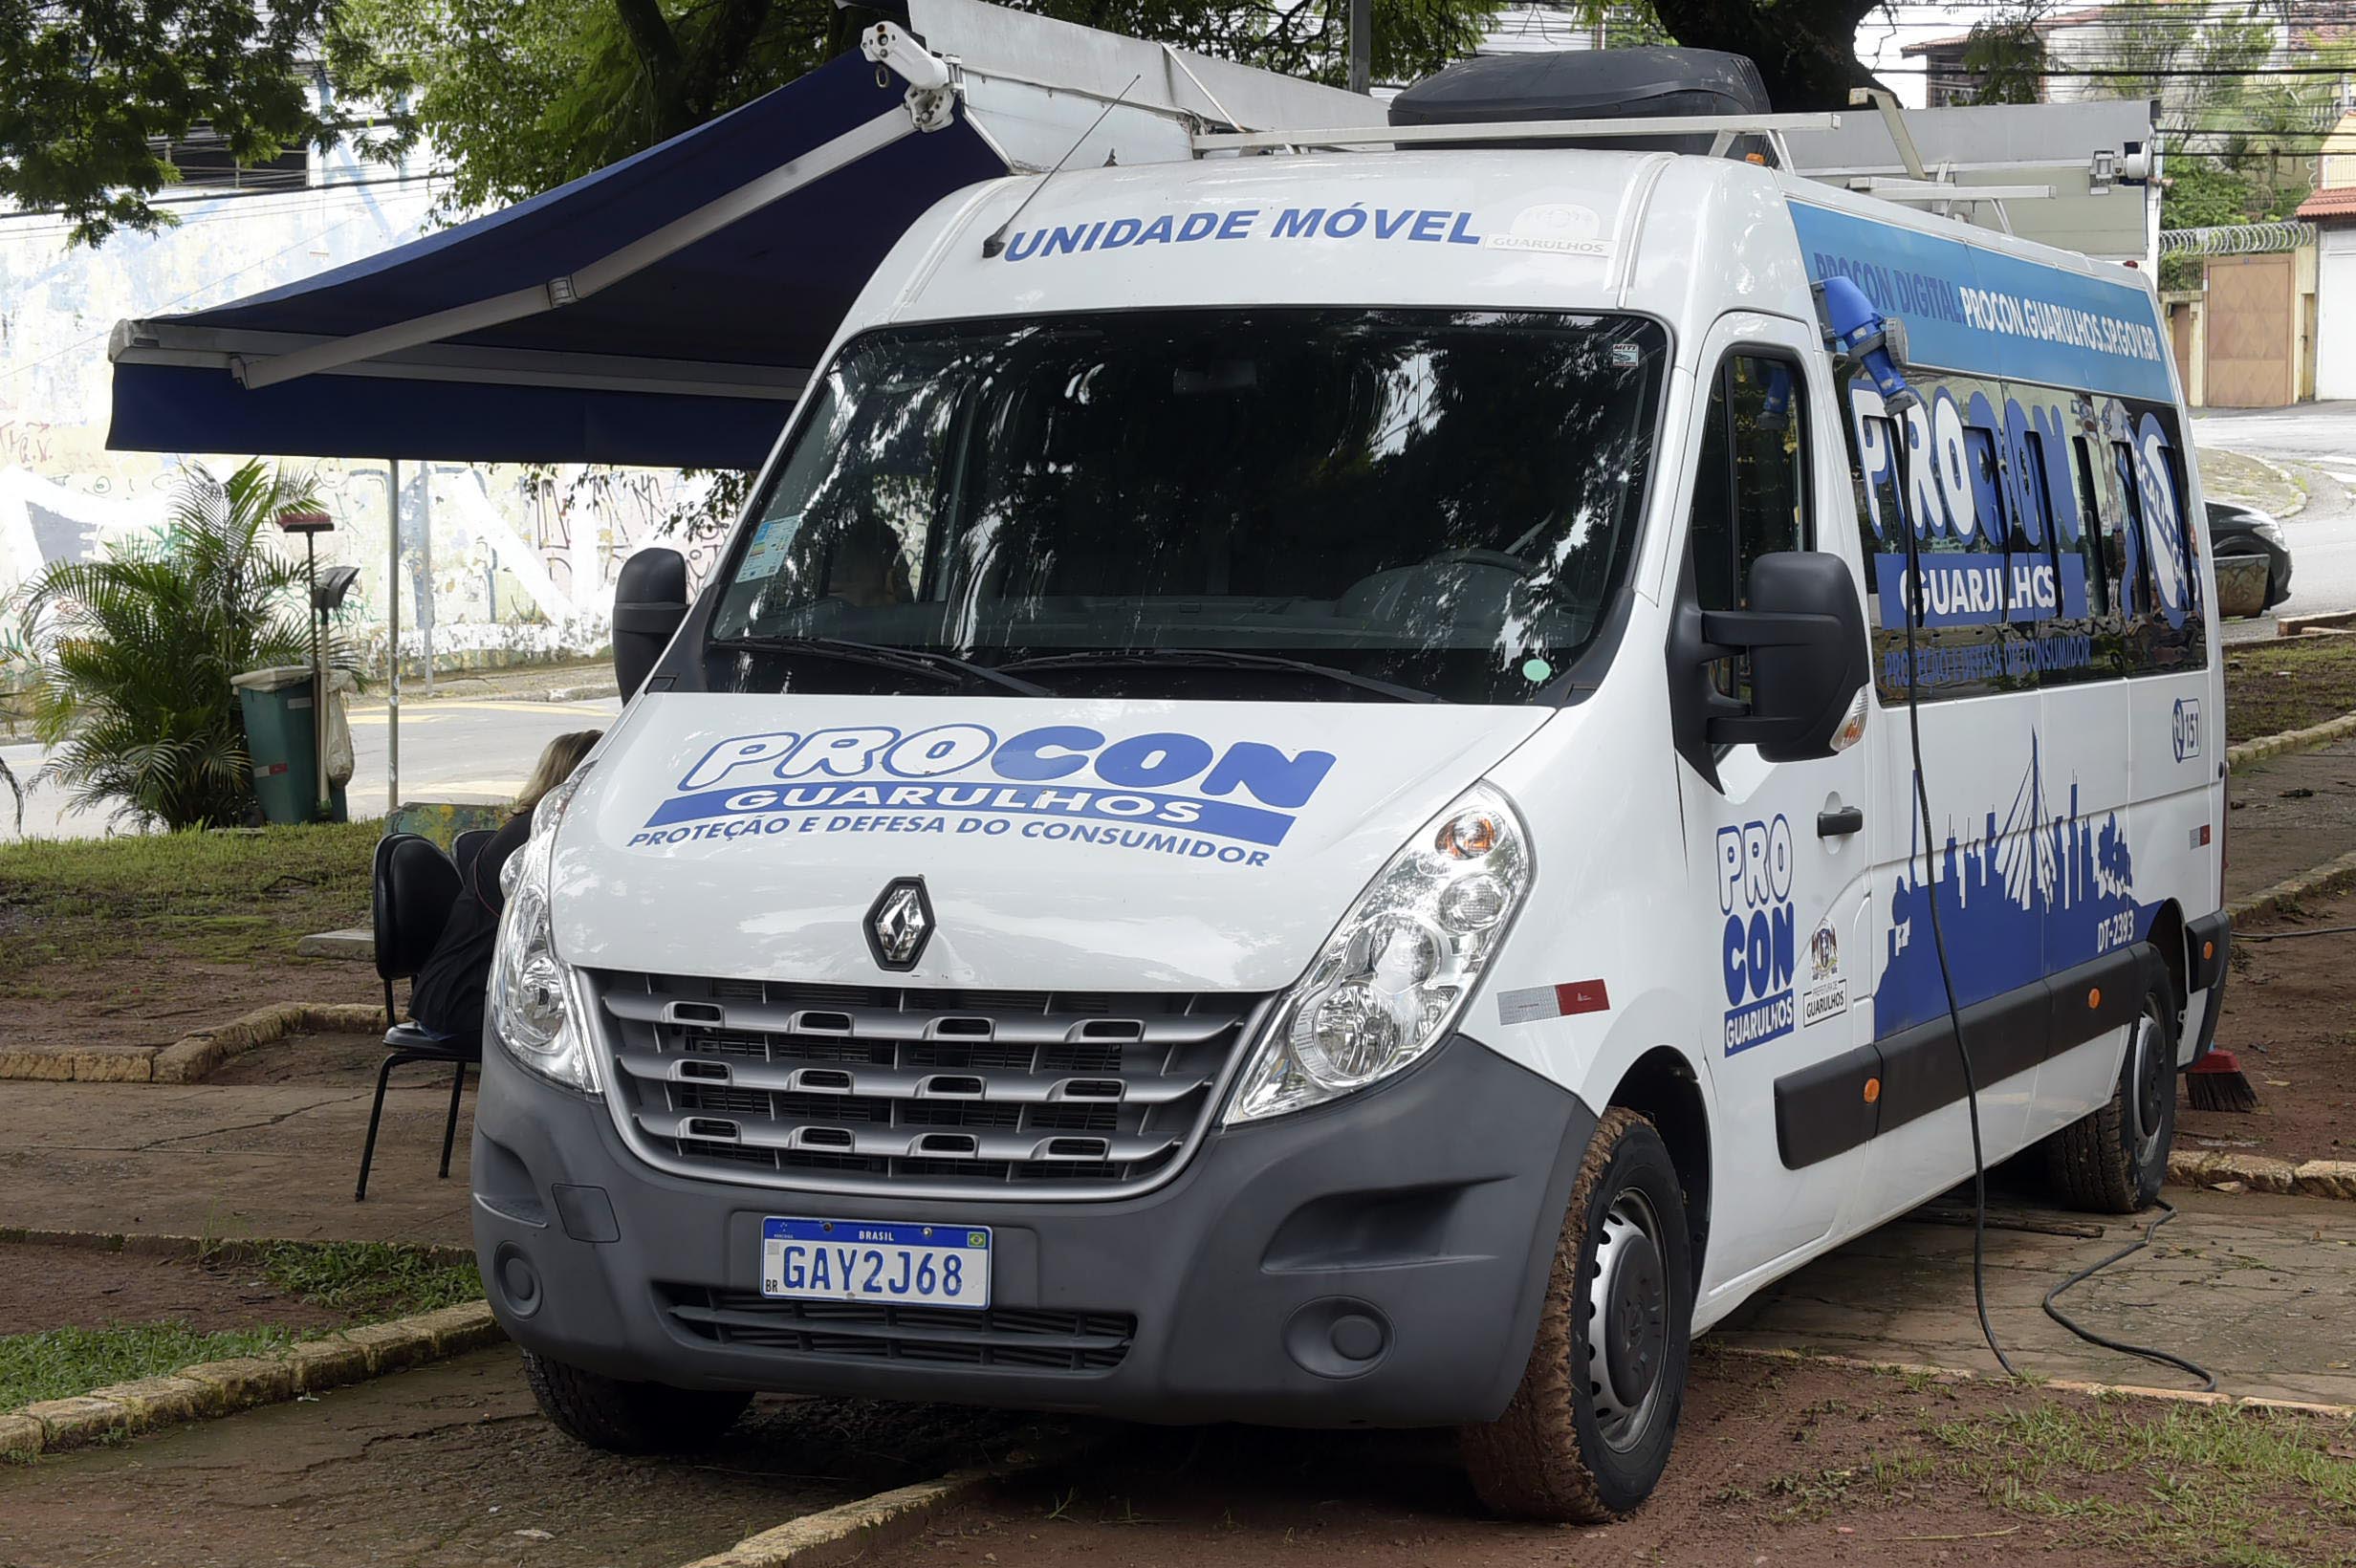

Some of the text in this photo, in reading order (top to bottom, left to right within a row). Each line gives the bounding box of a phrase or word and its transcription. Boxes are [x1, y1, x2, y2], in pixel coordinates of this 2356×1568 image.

[1005, 203, 1481, 262] UNIDADE MÓVEL
[1493, 237, 1605, 253] GUARULHOS
[2185, 712, 2199, 750] 151
[678, 723, 1338, 809] PROCON
[724, 786, 1203, 824] GUARULHOS
[626, 812, 1271, 868] PROTEÇÃO E DEFESA DO CONSUMIDOR
[1716, 813, 1794, 916] PRO
[1723, 901, 1795, 1007] CON
[2097, 908, 2135, 954] DT-2393
[1725, 995, 1794, 1049] GUARULHOS
[1806, 990, 1844, 1018] GUARULHOS
[859, 1230, 894, 1242] BRASIL
[765, 1278, 778, 1293] BR
[783, 1246, 963, 1296] GAY2J68
